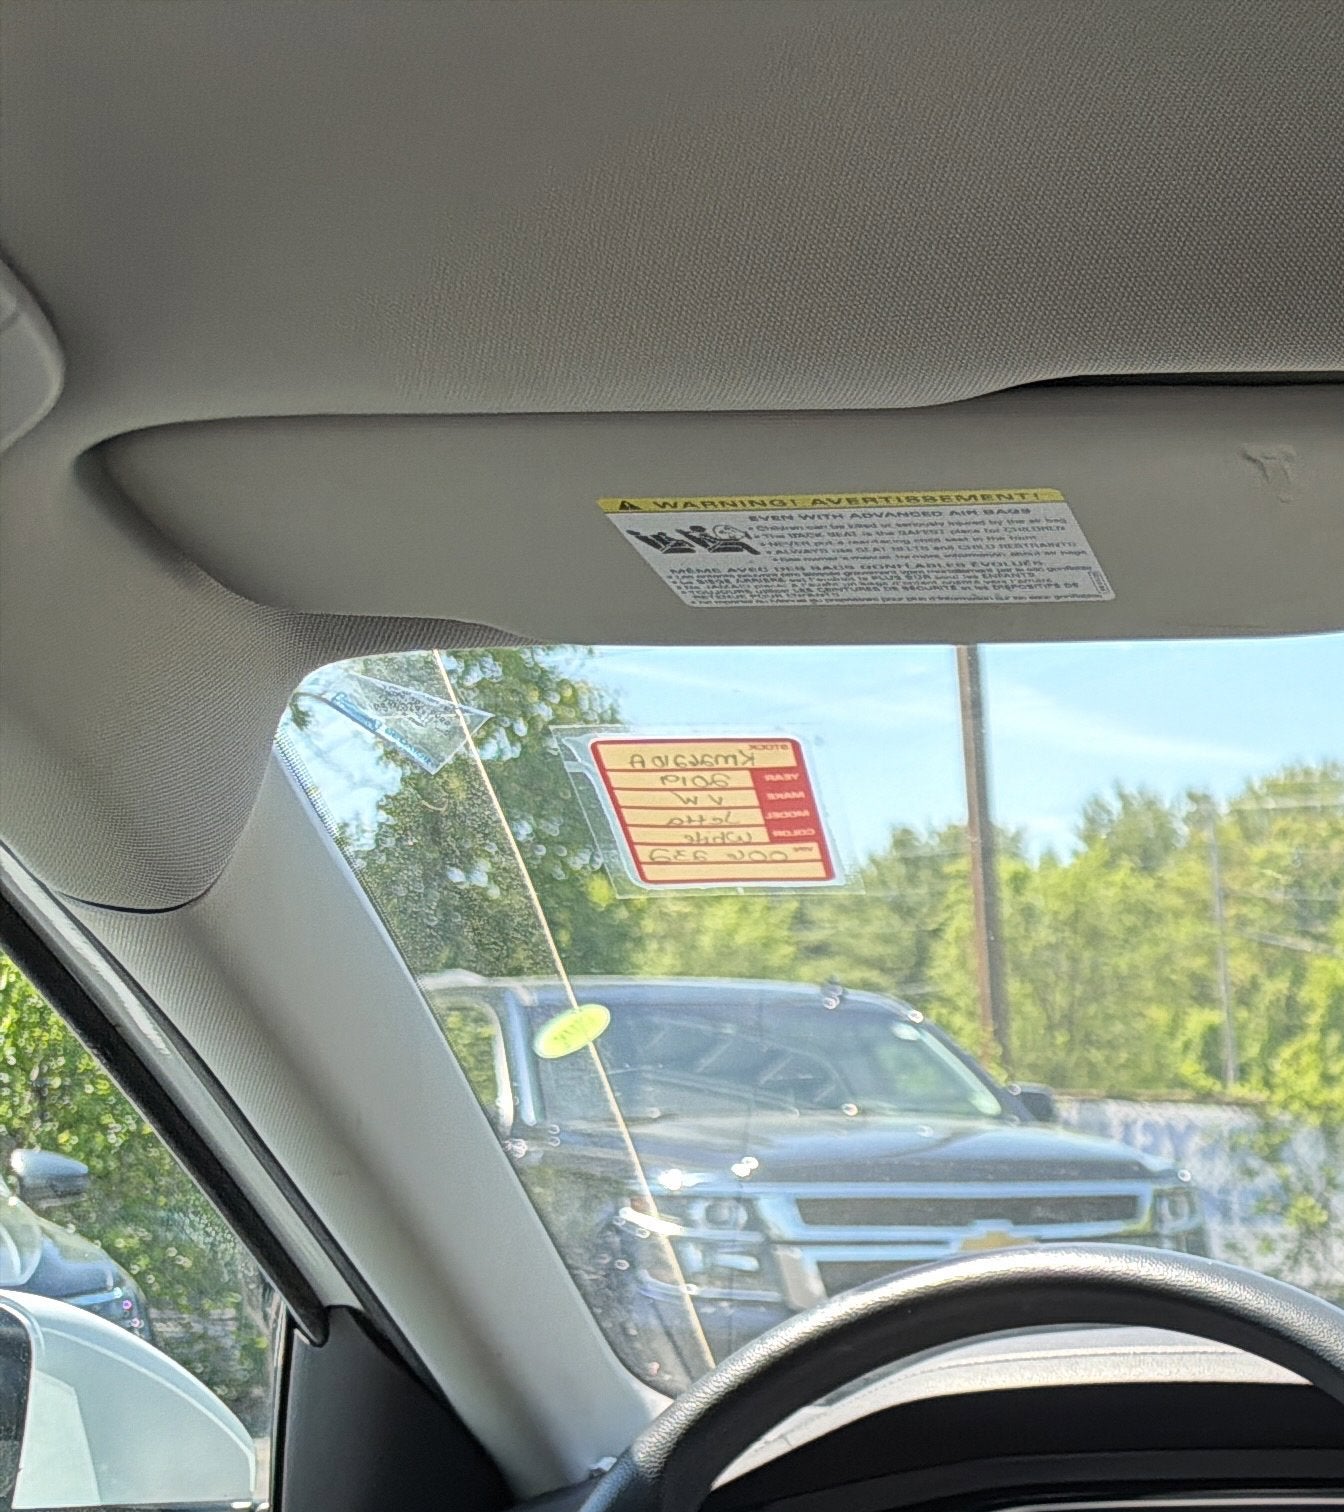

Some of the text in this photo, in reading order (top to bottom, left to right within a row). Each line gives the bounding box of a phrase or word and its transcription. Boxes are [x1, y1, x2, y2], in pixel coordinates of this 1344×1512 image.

[653, 492, 1040, 510] WARNING! AVERTISSEMENT!
[850, 511, 943, 519] ADVANCED
